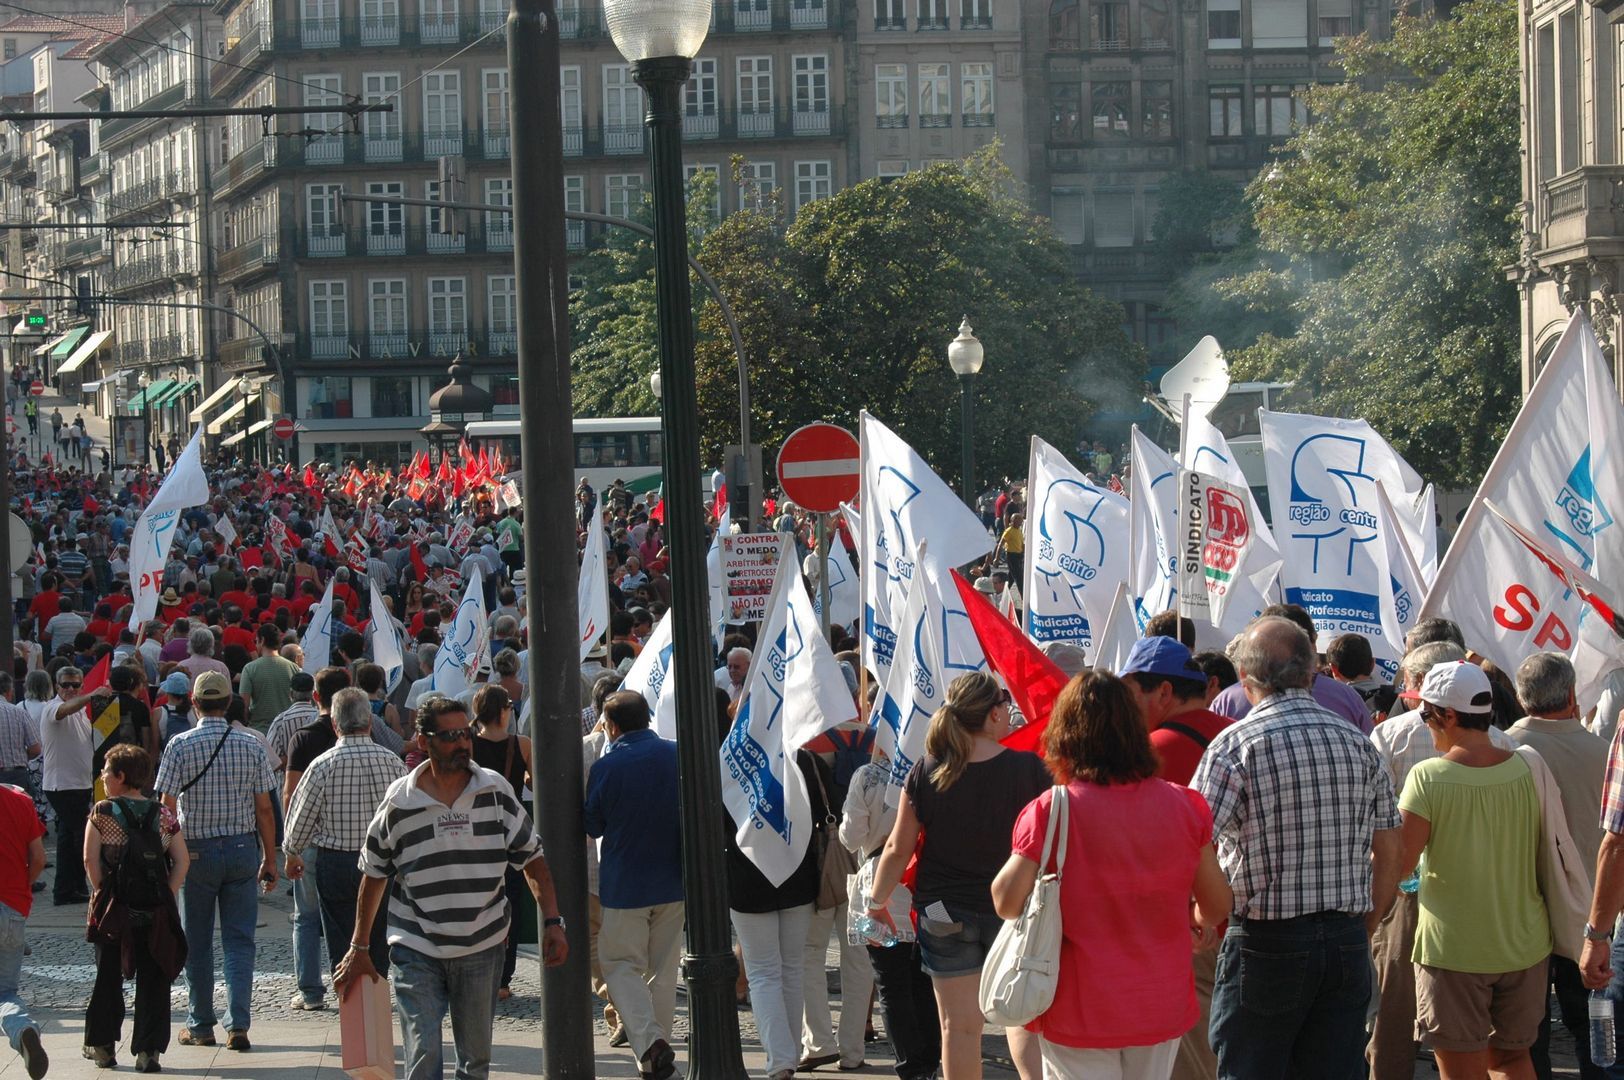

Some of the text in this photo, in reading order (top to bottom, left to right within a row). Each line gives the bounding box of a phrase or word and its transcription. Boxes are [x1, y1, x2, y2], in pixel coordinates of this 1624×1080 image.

[1290, 503, 1377, 529] região centr
[1186, 473, 1201, 574] SINDICATO
[737, 535, 780, 544] CONTRA
[747, 546, 778, 555] MEDO
[1058, 553, 1097, 581] centro
[730, 579, 773, 587] ESTAMO
[1309, 605, 1375, 620] Professores
[1033, 615, 1081, 628] Sindicato
[1339, 621, 1382, 635] Centro
[724, 752, 750, 794] Região
[441, 812, 465, 821] NEWS
